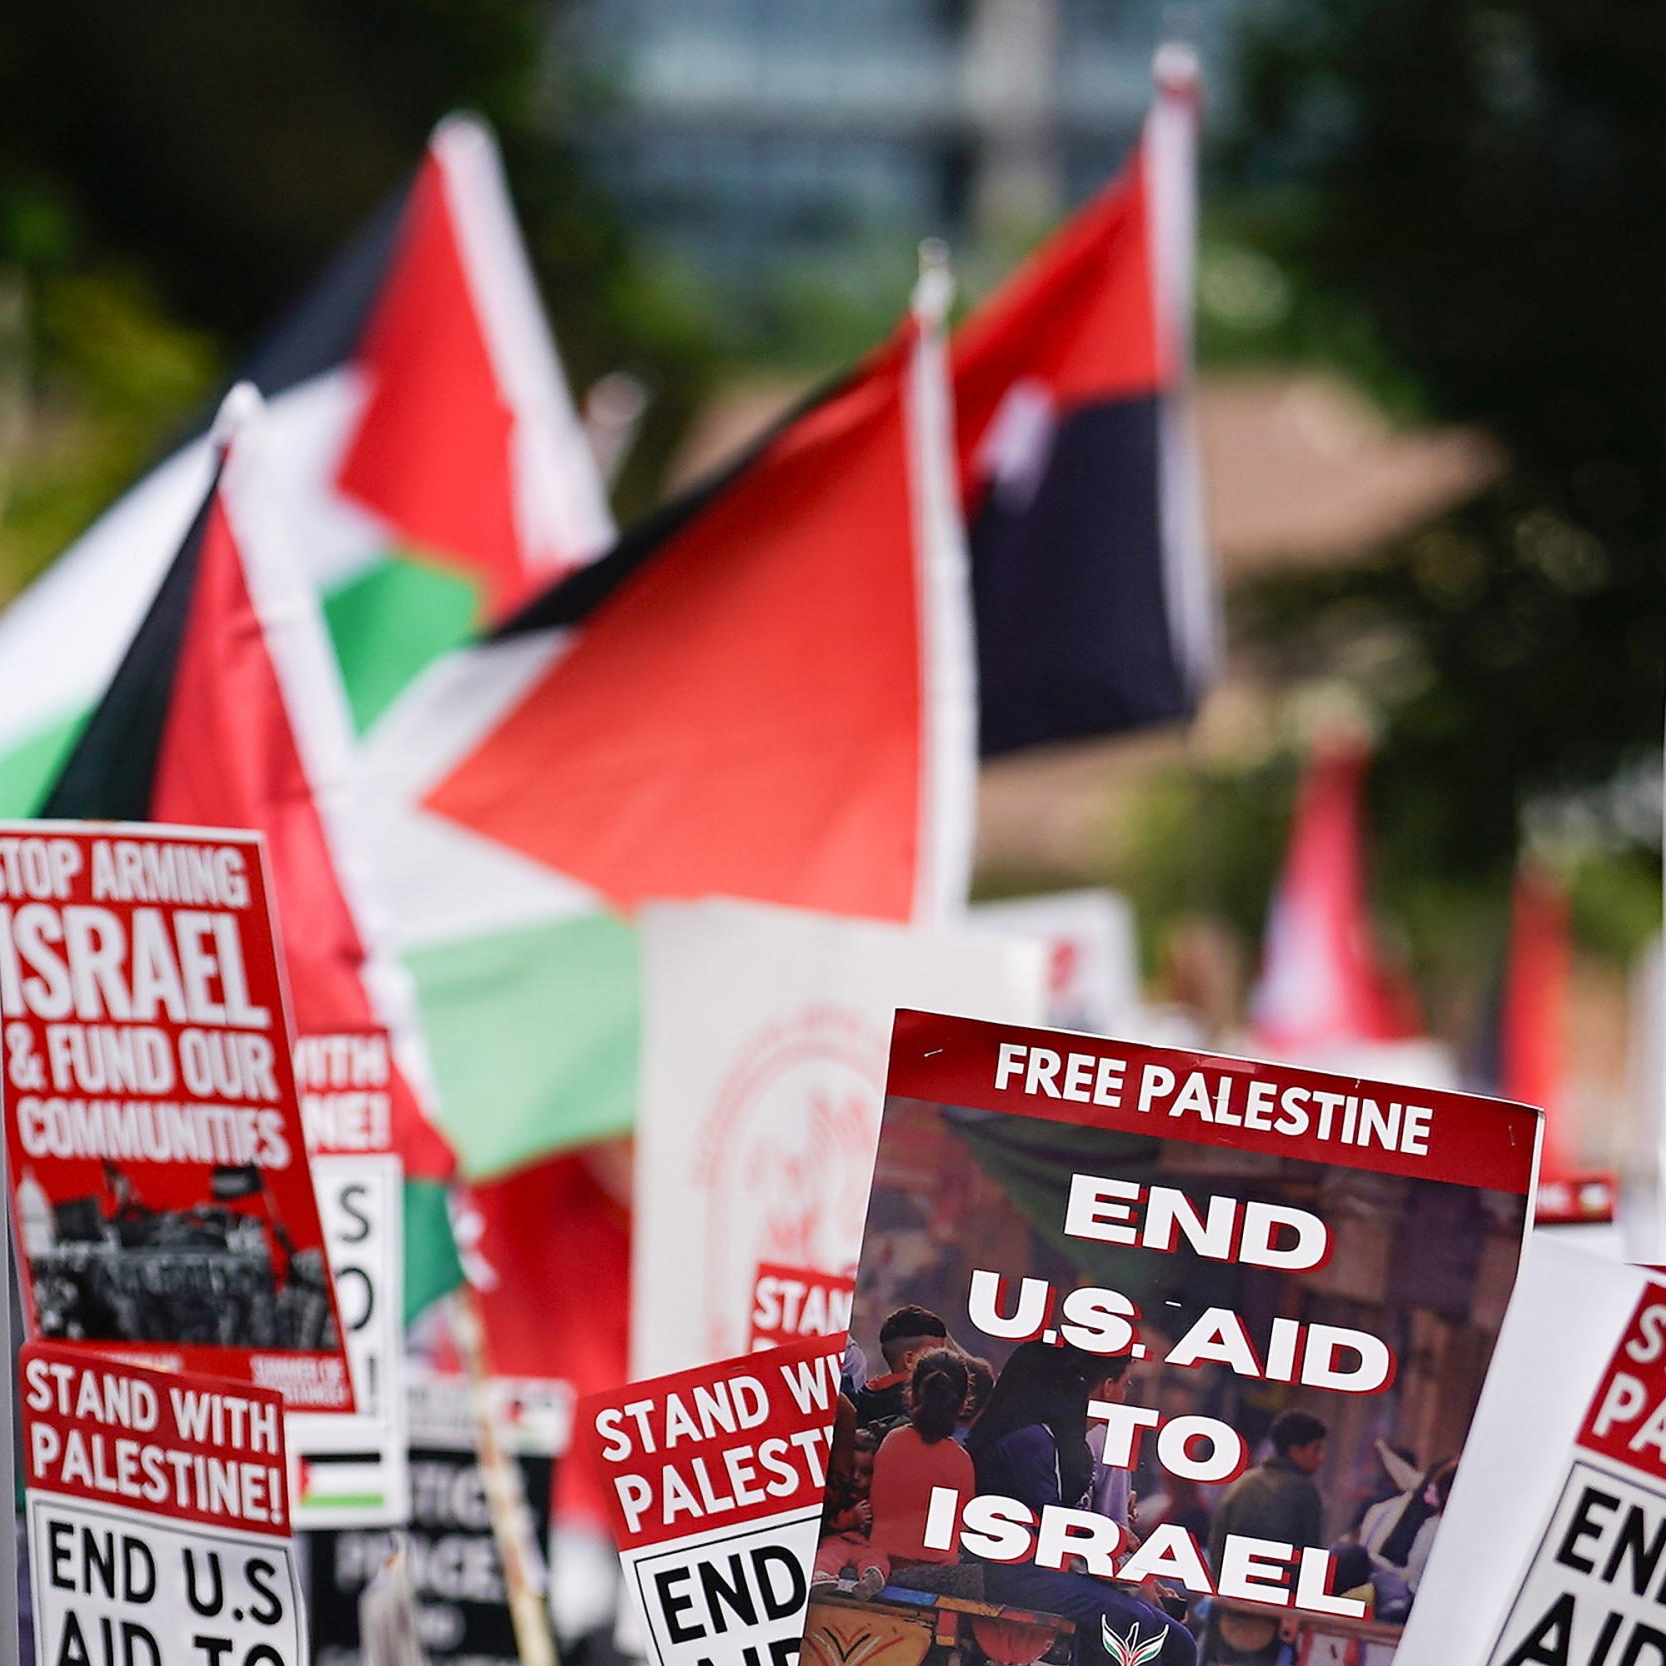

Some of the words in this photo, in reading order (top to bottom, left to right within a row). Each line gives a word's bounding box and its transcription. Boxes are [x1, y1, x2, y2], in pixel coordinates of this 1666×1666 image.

[92, 841, 250, 909] ARMING
[0, 904, 271, 1029] ISRAEL
[5, 1023, 45, 1091] &
[46, 1024, 174, 1096] FUND
[180, 1028, 278, 1101] OUR
[995, 1042, 1127, 1107] FREE
[1139, 1063, 1434, 1156] PALESTINE
[17, 1098, 291, 1170] COMMUNITIES
[1063, 1173, 1332, 1273] END
[967, 1269, 1144, 1360] U.S.
[1164, 1307, 1397, 1395] AID
[25, 1358, 159, 1441] STAND
[169, 1387, 279, 1455] WITH
[594, 1374, 770, 1463] STAND
[779, 1351, 848, 1414] WI
[1086, 1401, 1247, 1485] TO
[31, 1428, 283, 1526] PALESTINE!
[49, 1521, 159, 1605] END
[183, 1546, 284, 1626] U.S
[654, 1544, 808, 1645] END
[923, 1485, 1374, 1619] ISRAEL
